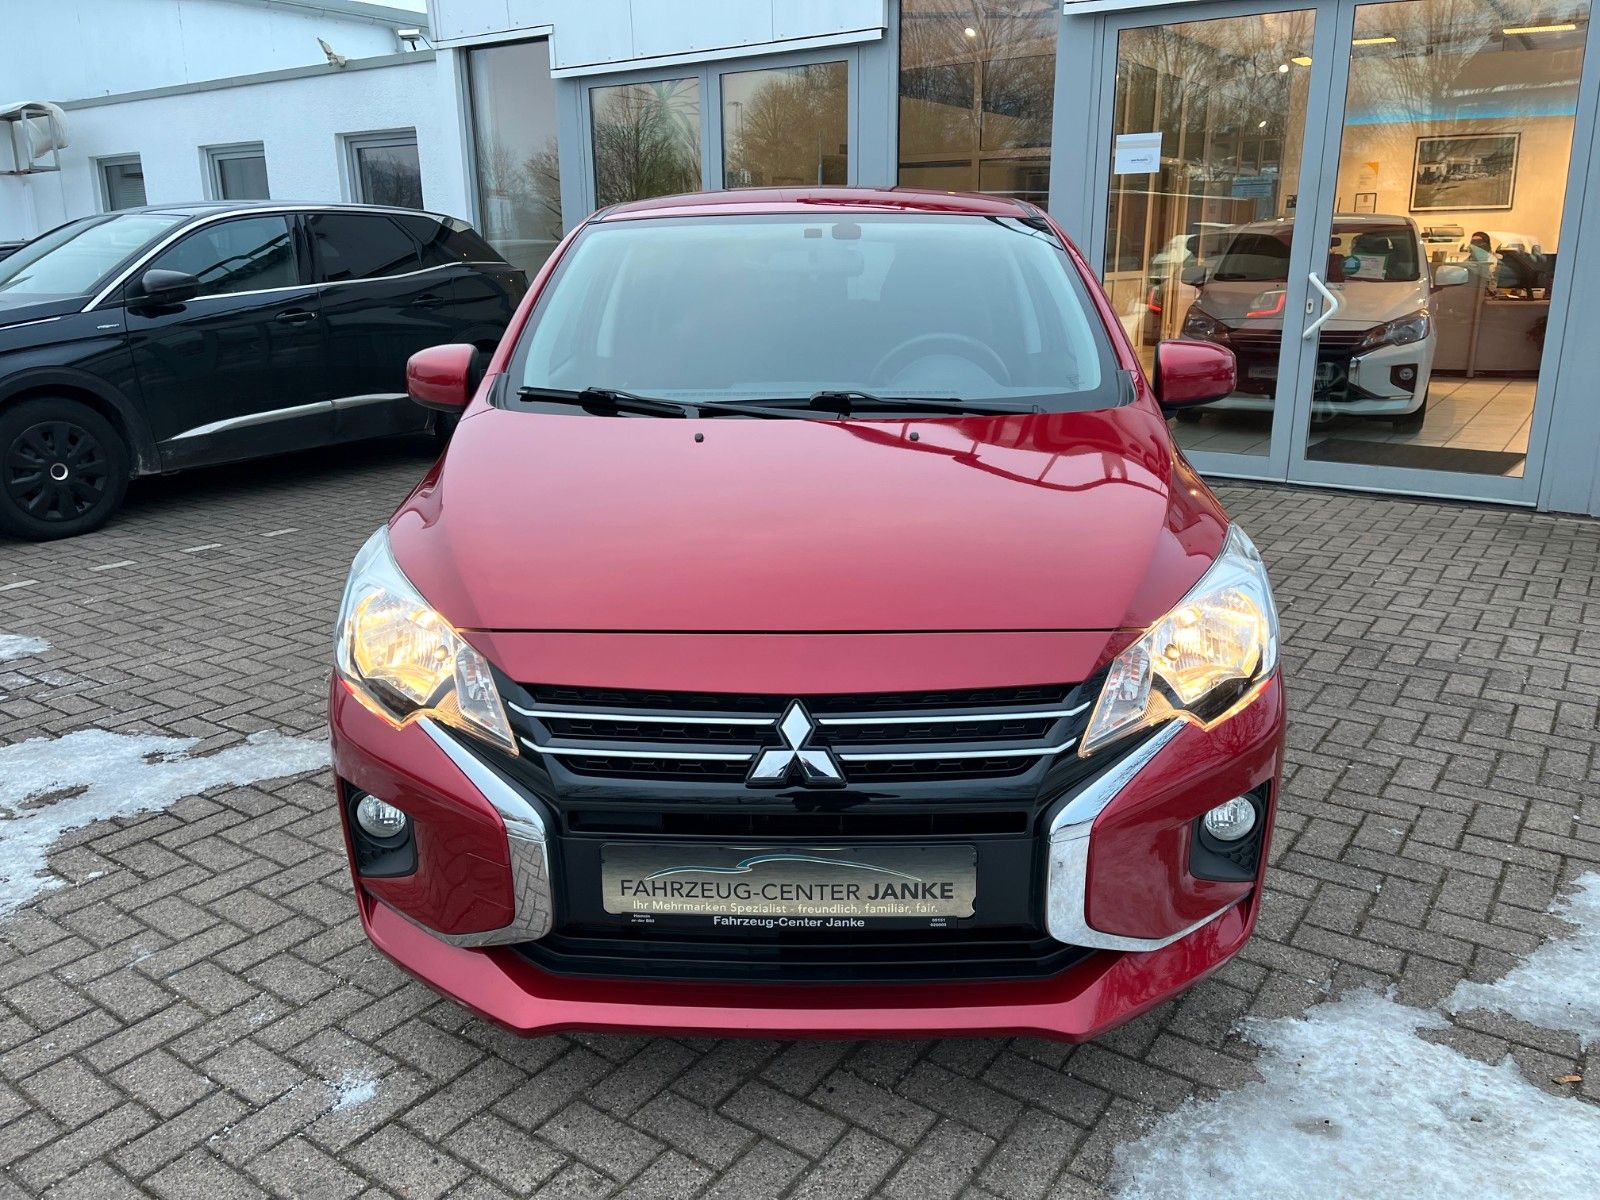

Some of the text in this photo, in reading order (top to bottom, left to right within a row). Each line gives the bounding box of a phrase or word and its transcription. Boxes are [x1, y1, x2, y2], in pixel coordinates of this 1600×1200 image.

[620, 879, 954, 901] FAHRZEUG-CENTER JANKE
[633, 900, 648, 910] Ihr
[652, 901, 727, 912] Mehrmarken
[730, 902, 787, 915] Spezialist
[798, 904, 862, 915] freundlich,
[865, 903, 912, 914] familiär,
[916, 903, 938, 913] fair.
[713, 916, 865, 929] Fahrzeug-Center Janke
